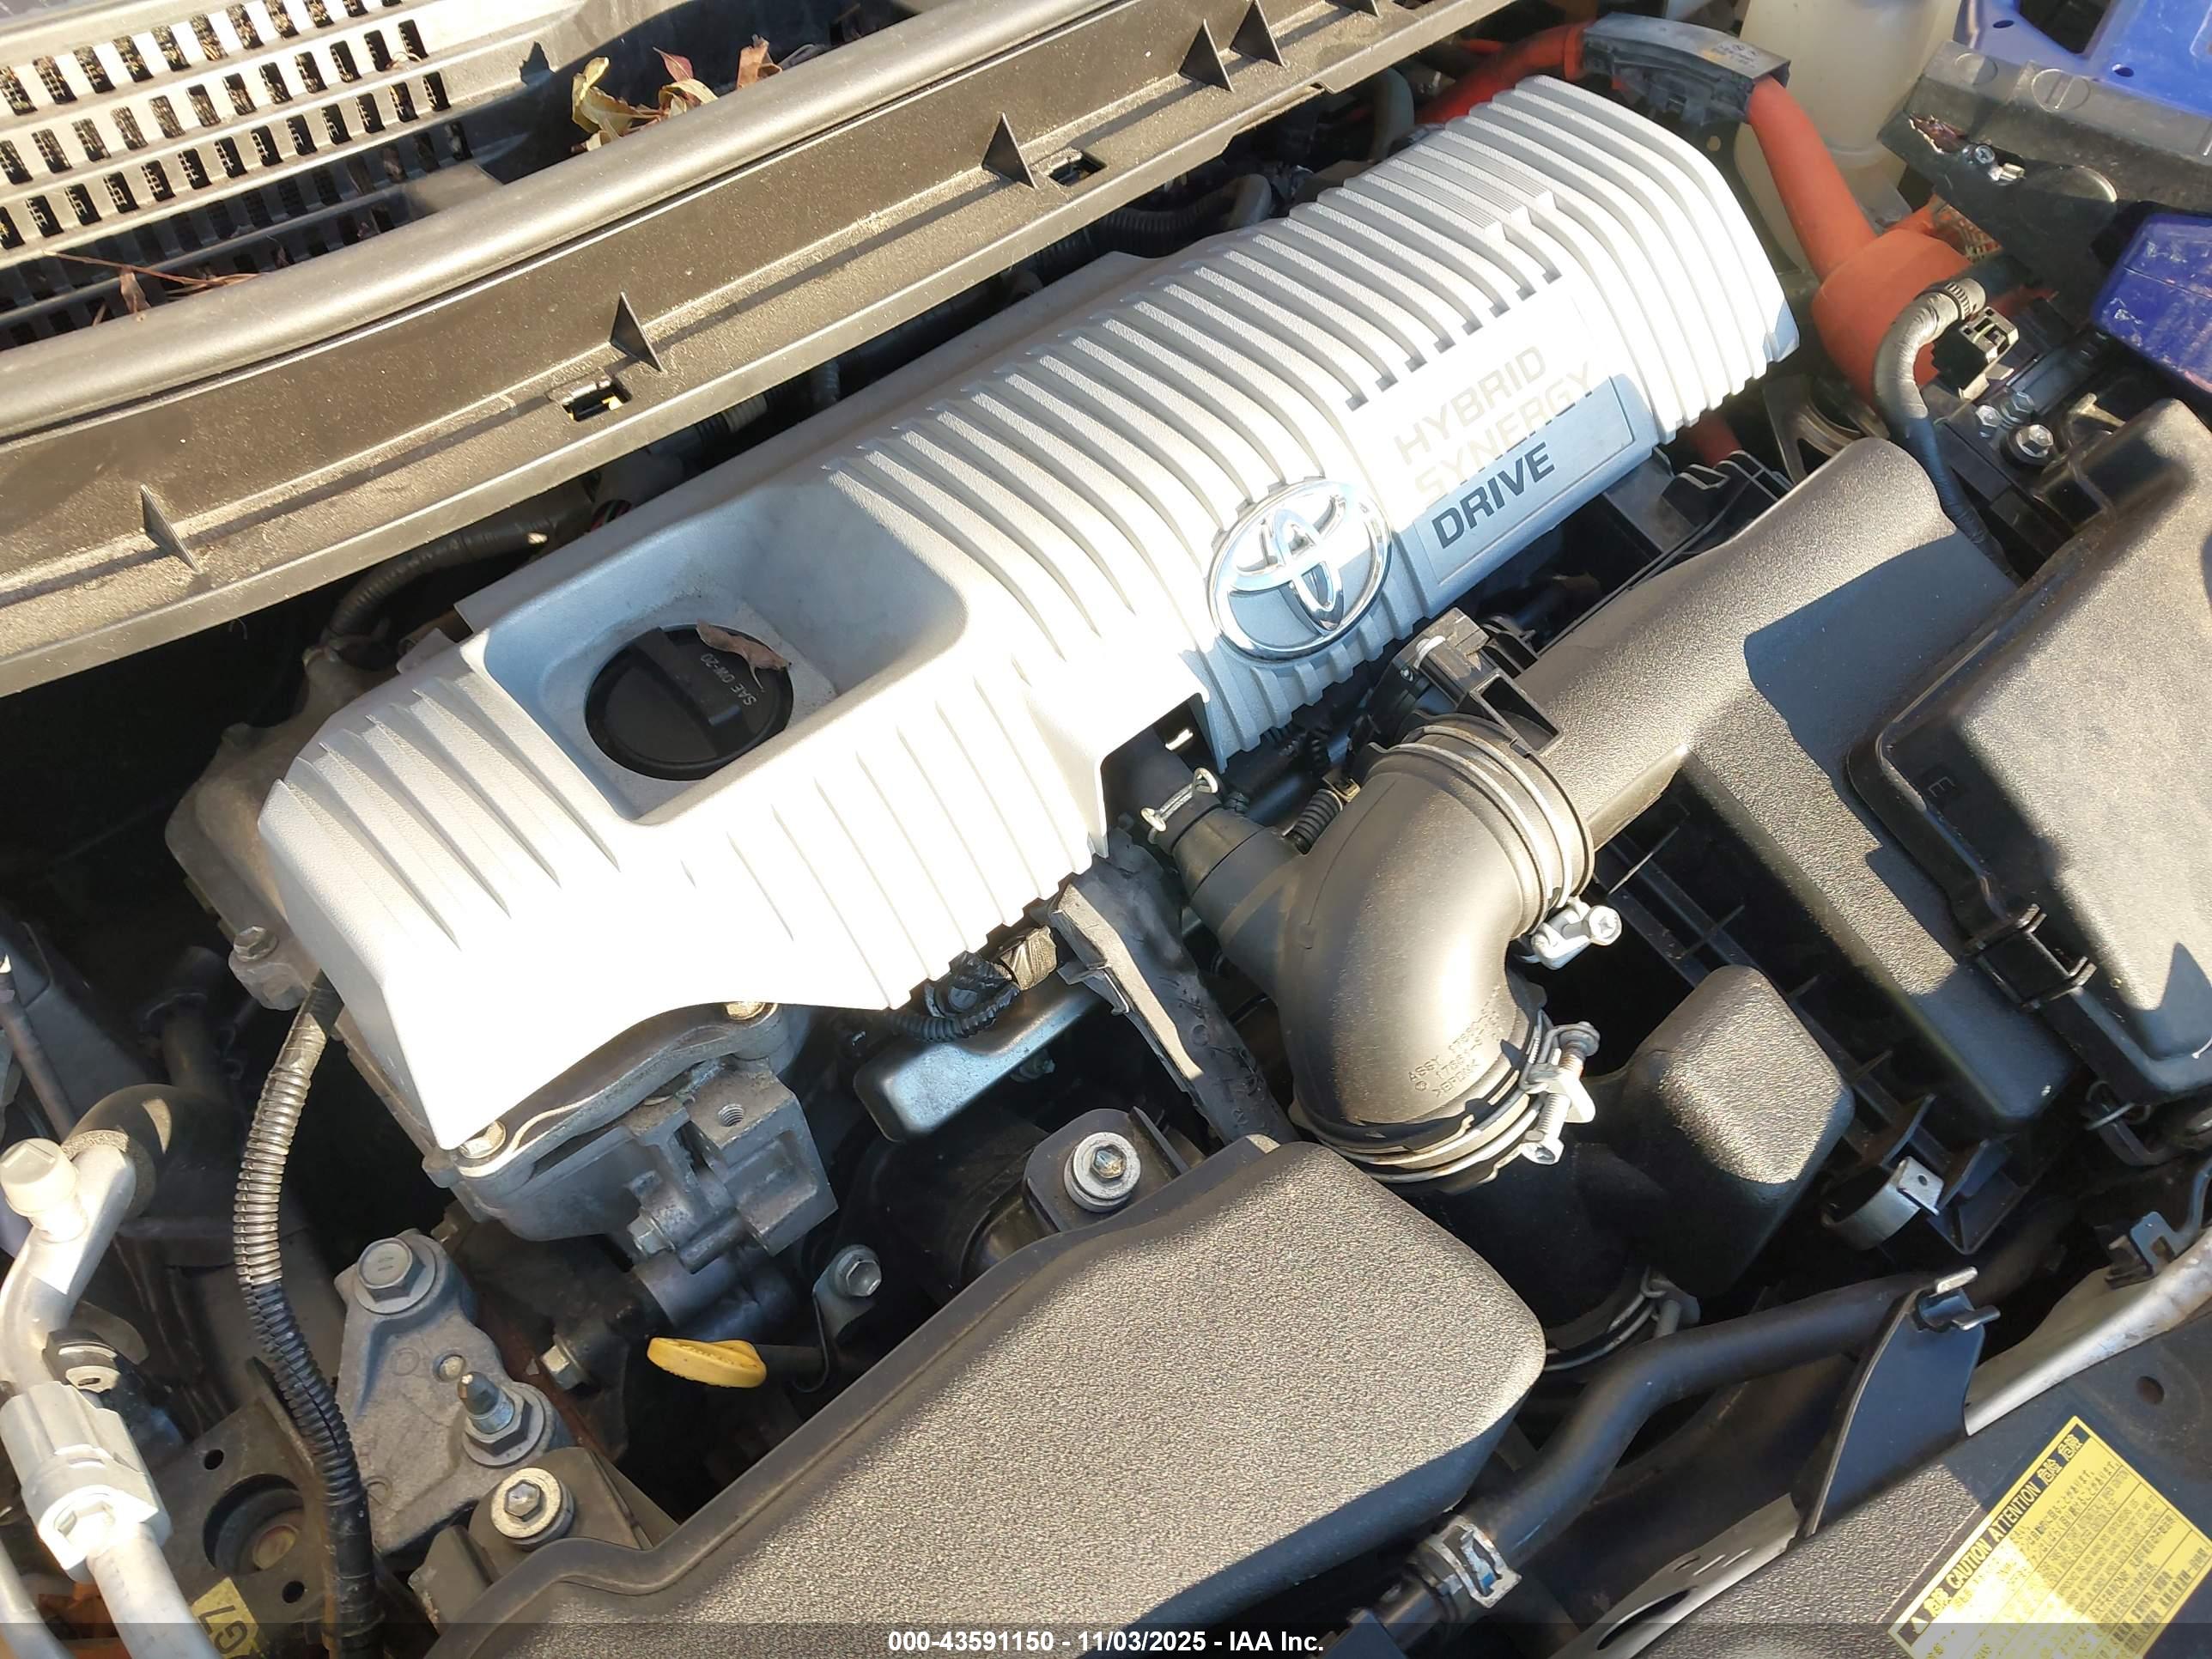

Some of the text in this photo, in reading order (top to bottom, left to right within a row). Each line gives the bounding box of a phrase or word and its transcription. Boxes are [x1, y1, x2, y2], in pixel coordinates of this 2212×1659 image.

[1394, 345, 1546, 466] HYBRID
[1414, 360, 1592, 511] SYNERGY
[1431, 441, 1555, 550] DRIVE
[730, 682, 757, 706] SAE
[1408, 1054, 1443, 1082] ASSY
[1946, 1538, 1993, 1589] CAUTION
[1990, 1481, 2041, 1543] ATTENTION
